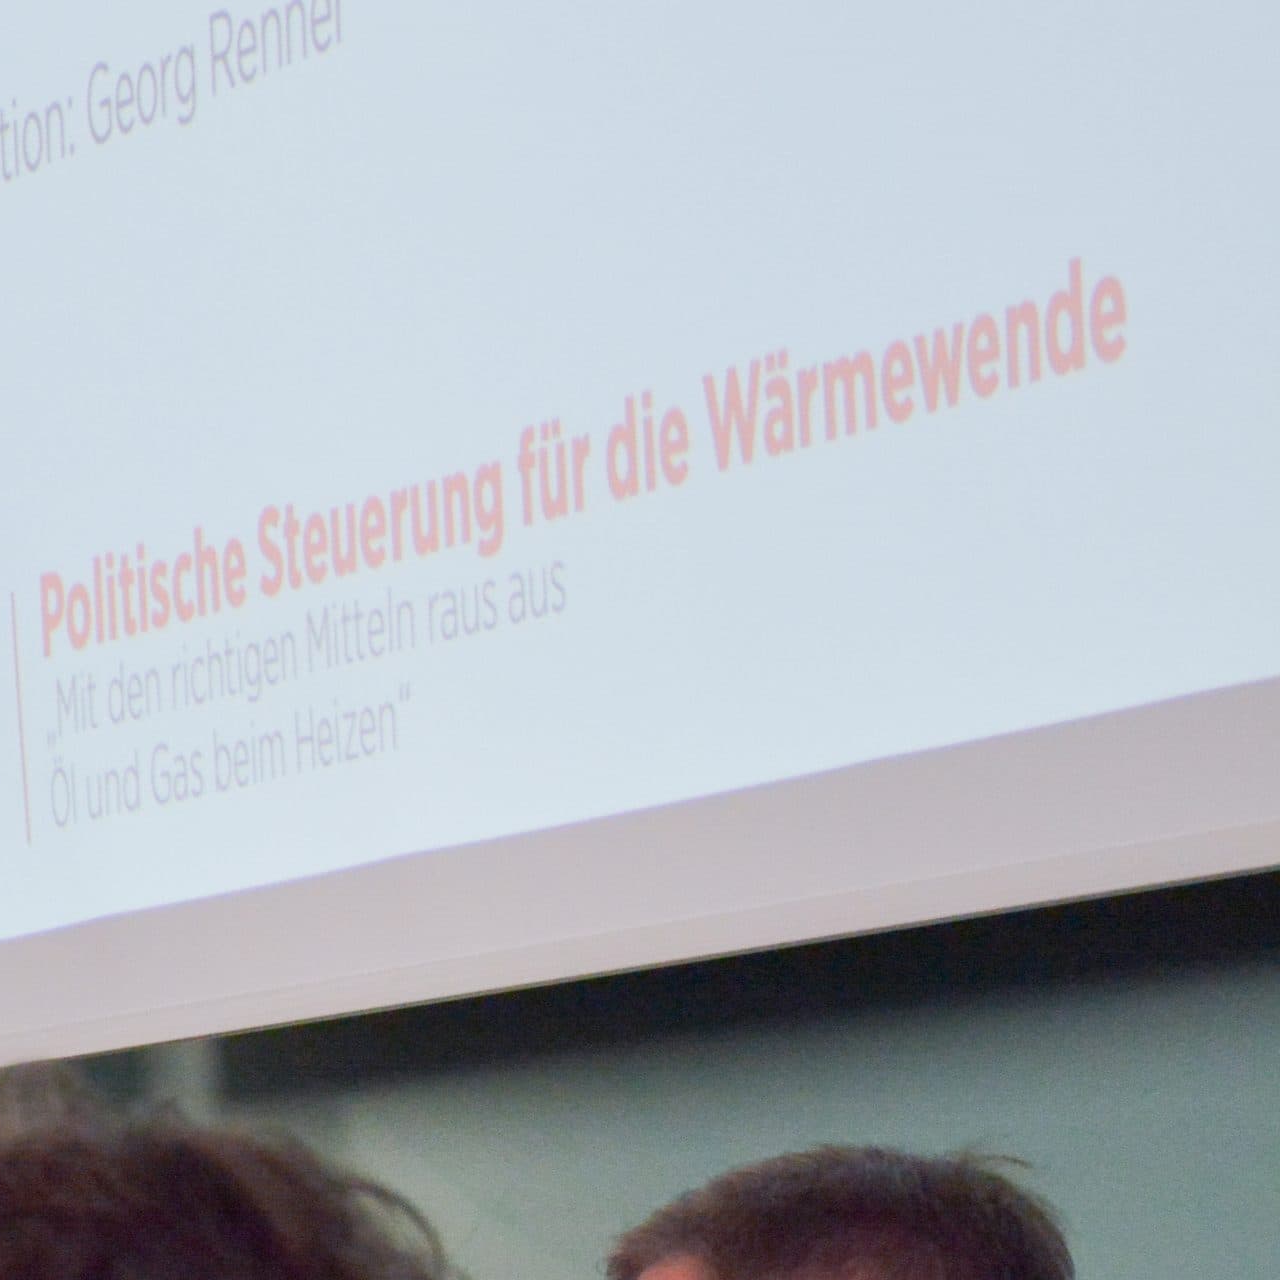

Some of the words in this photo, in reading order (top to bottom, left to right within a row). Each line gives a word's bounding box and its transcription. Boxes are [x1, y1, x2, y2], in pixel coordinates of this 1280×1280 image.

[86, 42, 197, 145] Georg
[40, 525, 246, 658] Politische
[257, 460, 504, 598] Steuerung
[518, 417, 590, 527] für
[606, 388, 690, 501] die
[702, 256, 1128, 472] Wärmewende
[108, 659, 161, 724] den
[171, 629, 298, 711] richtigen
[306, 586, 415, 673] Mitteln
[428, 579, 498, 645] raus
[508, 560, 566, 625] aus
[51, 754, 77, 828] Öl
[86, 747, 141, 820] und
[151, 740, 204, 805] Gas
[213, 720, 287, 792] beim
